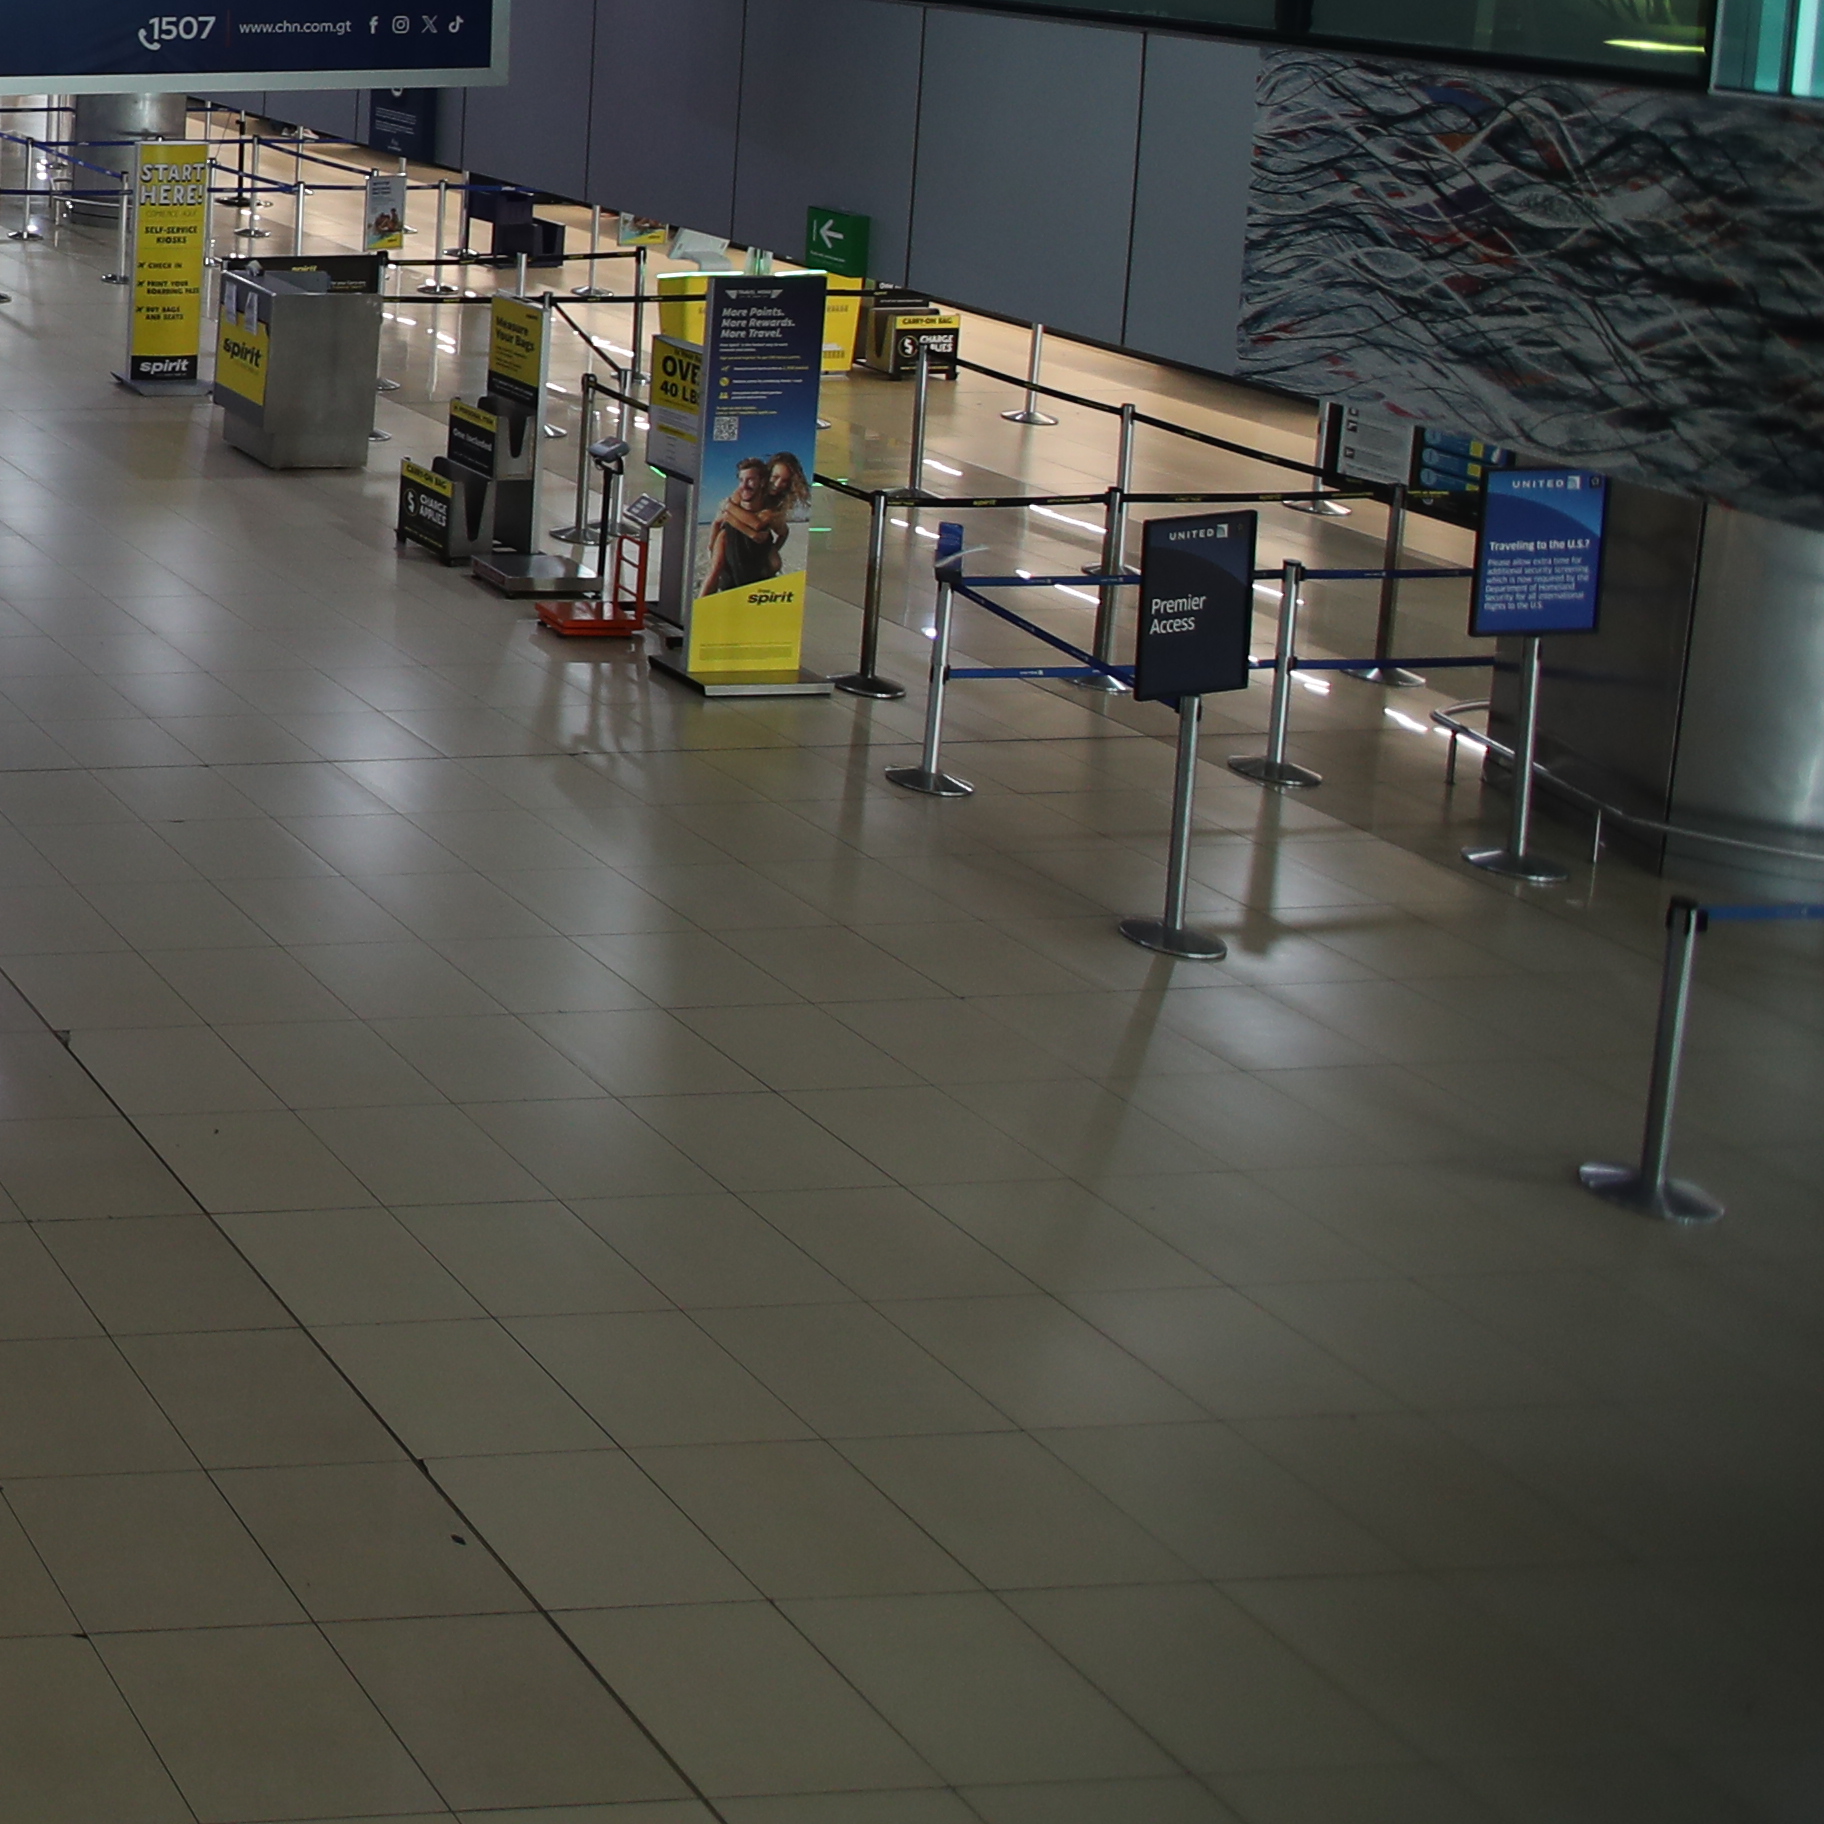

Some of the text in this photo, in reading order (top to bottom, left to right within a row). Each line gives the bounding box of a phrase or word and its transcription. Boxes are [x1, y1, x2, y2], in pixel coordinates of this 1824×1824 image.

[149, 16, 352, 40] 1507 www.chn.com.gt
[140, 164, 206, 184] START
[139, 184, 204, 206] HERE!
[721, 306, 786, 317] More Points.
[721, 317, 796, 328] More Rewards.
[719, 328, 783, 339] More Travel.
[222, 337, 264, 369] spirit
[139, 358, 190, 376] spirit
[662, 355, 703, 386] OVE
[659, 380, 701, 405] 40 LB
[1512, 478, 1564, 489] UNITED
[1168, 527, 1215, 541] UNITED
[1489, 538, 1591, 553] Traveling to the U.S.?
[747, 590, 794, 606] spirit
[1152, 593, 1207, 616] Premier
[1149, 616, 1196, 636] Access
